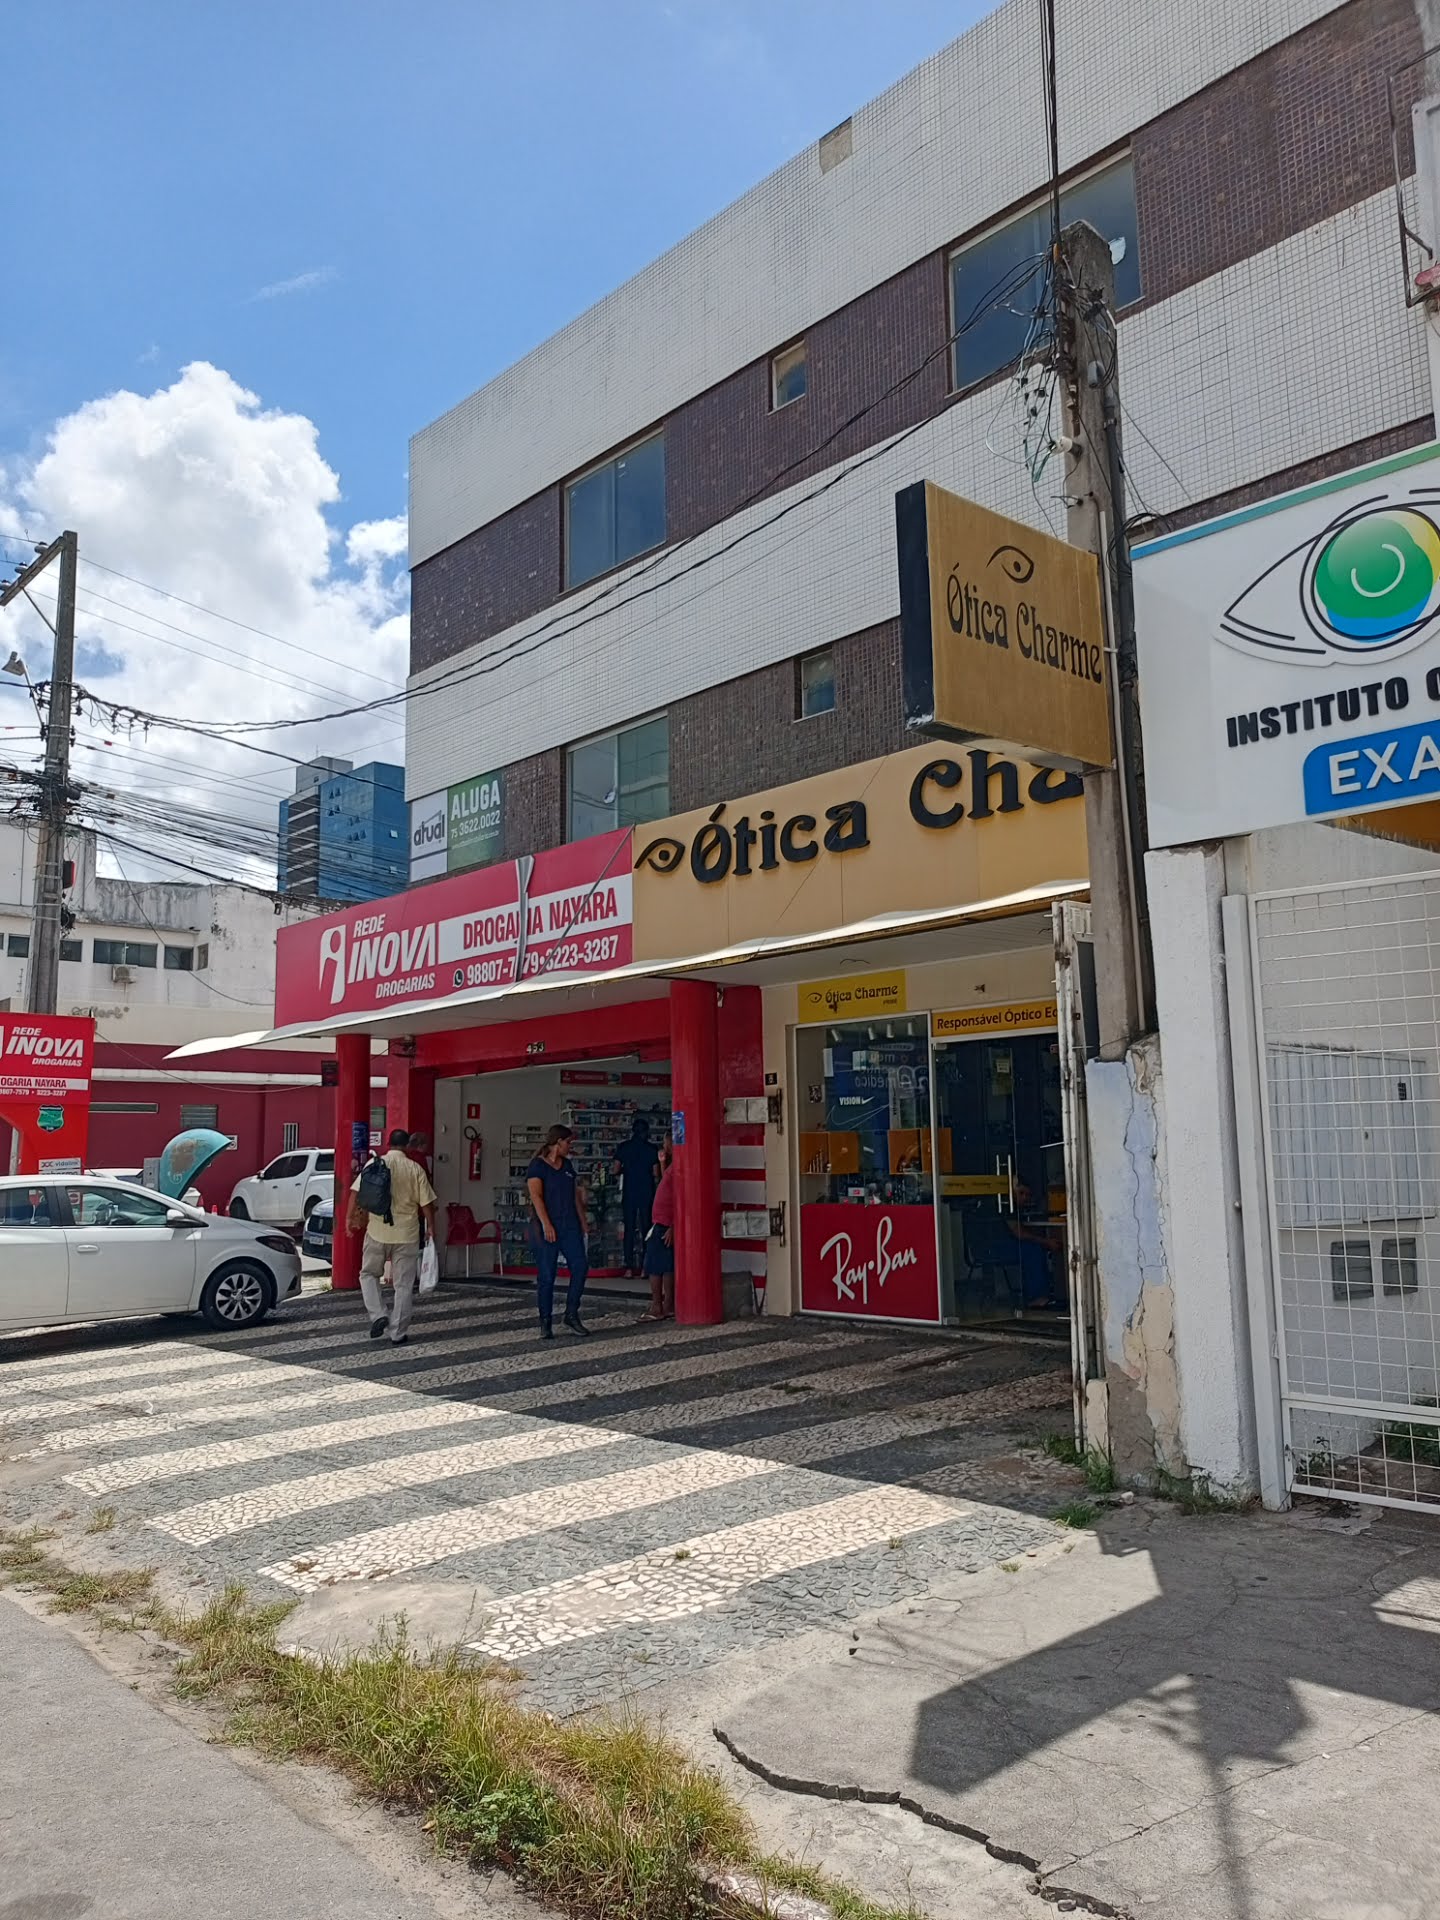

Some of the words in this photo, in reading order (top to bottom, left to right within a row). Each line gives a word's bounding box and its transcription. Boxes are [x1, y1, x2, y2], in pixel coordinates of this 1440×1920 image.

[947, 562, 1009, 649] Ótica
[1016, 602, 1103, 684] Charme
[1226, 676, 1409, 747] INSTITUTO
[1328, 735, 1440, 795] EXA
[451, 780, 500, 821] ALUGA
[451, 828, 458, 839] 75
[690, 801, 870, 883] Ótica
[550, 887, 618, 932] NAYARA
[353, 913, 386, 939] REDE
[347, 922, 436, 984] INOVA
[375, 972, 435, 999] DROGARIAS
[855, 985, 898, 999] Charme
[12, 1026, 42, 1036] REDE
[937, 1011, 1002, 1030] Responsável
[1004, 1008, 1042, 1024] Óptico
[5, 1036, 84, 1058] INOVA
[32, 1057, 82, 1067] DROGARIAS
[35, 1078, 67, 1088] NAYARA
[838, 1096, 861, 1106] VISION
